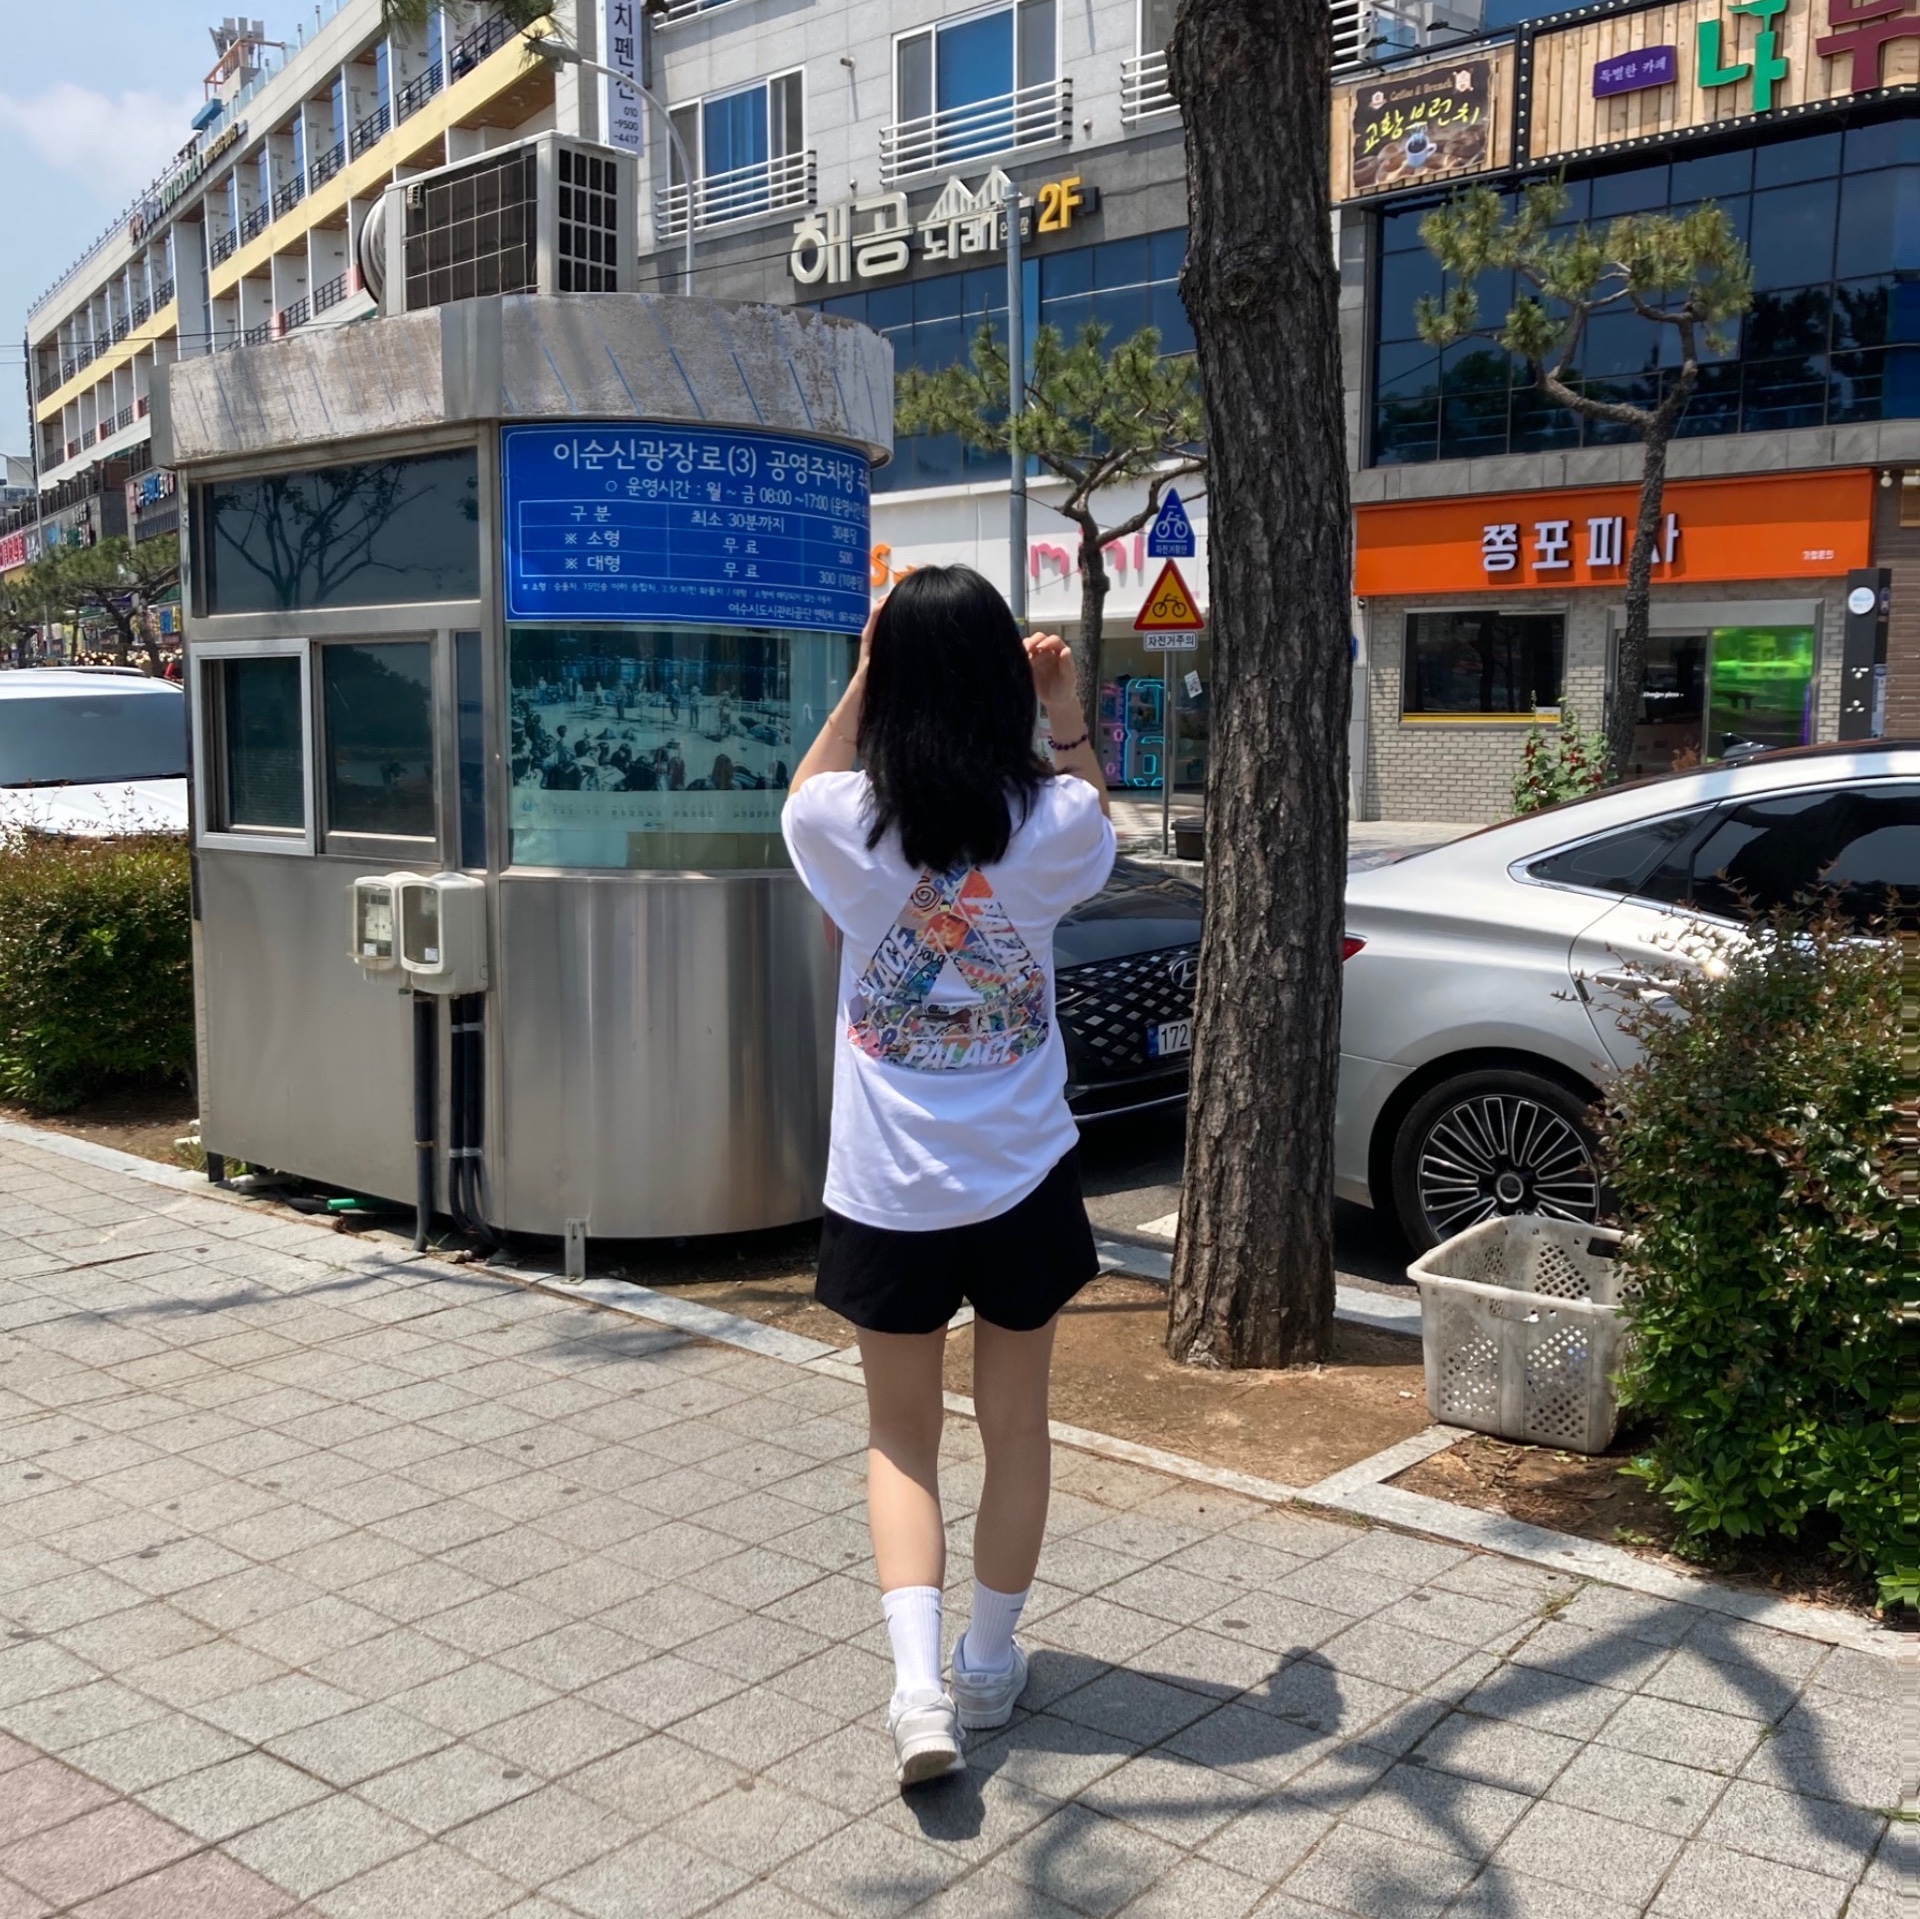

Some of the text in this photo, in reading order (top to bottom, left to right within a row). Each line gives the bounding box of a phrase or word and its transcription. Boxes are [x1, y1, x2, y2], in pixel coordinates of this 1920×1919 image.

[614, 0, 635, 101] 치펜션
[1599, 63, 1638, 83] 특별한
[623, 105, 639, 118] 010
[614, 132, 639, 145] -4417
[790, 190, 914, 284] 해공
[1038, 176, 1083, 233] 2F
[553, 438, 757, 478] 이순신광장로(3)
[766, 449, 856, 494] 공영주차장
[626, 476, 692, 500] 운영시간
[741, 485, 756, 504] 금
[759, 486, 793, 506] 08:00
[690, 509, 785, 533] 최소 30분까지
[586, 529, 621, 548] 소형
[586, 554, 621, 573] 대형
[1148, 633, 1195, 648] 자전거주의
[1161, 1023, 1188, 1050] 172
